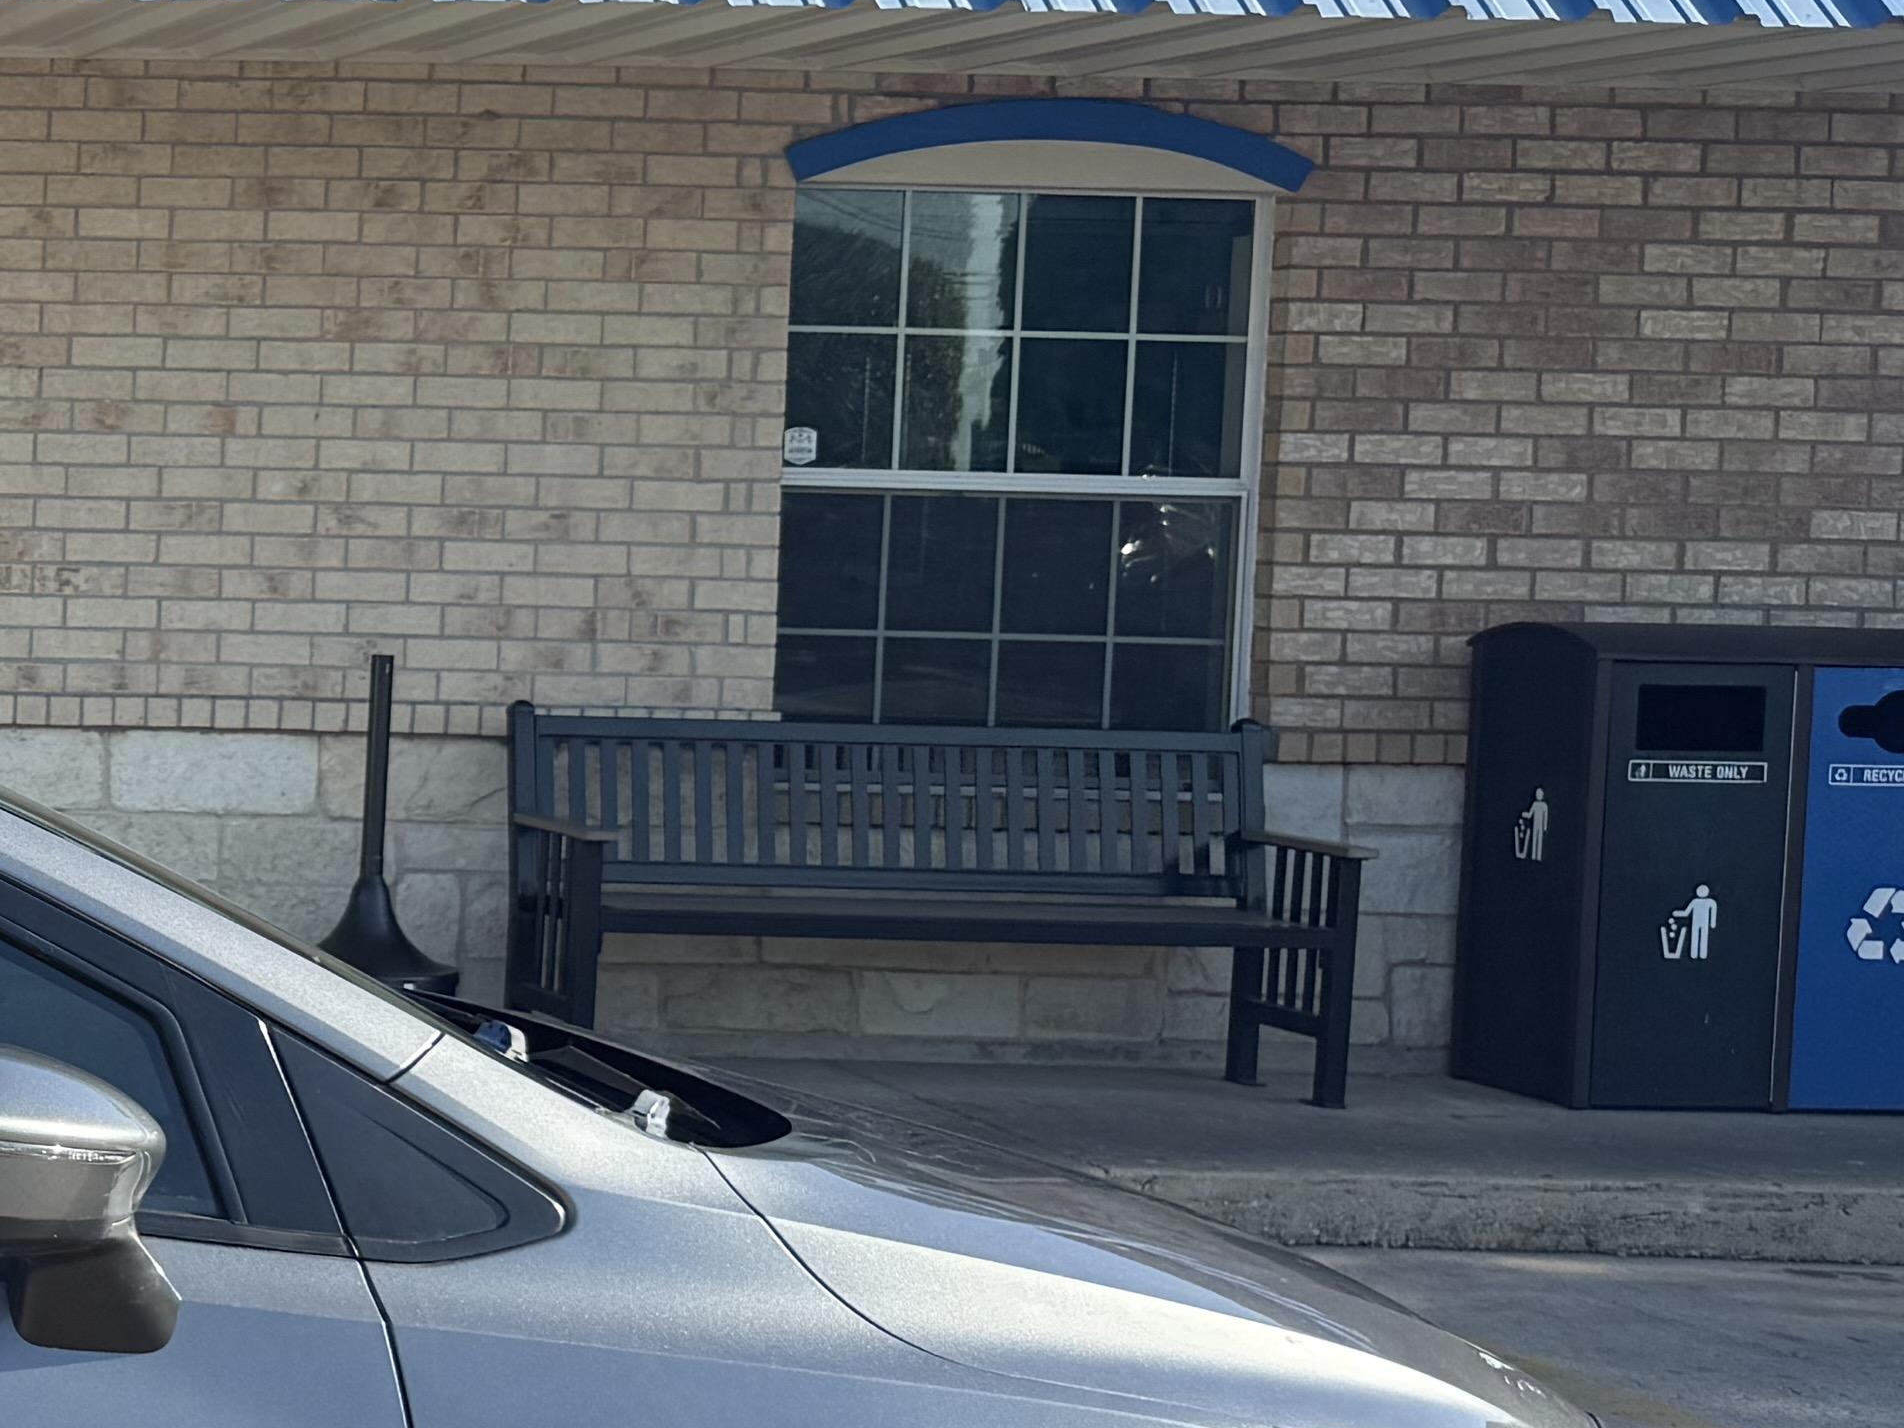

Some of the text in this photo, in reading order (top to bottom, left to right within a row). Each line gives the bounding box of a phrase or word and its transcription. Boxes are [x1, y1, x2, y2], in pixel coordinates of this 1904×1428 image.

[1669, 764, 1749, 780] WASTE ONLY
[1863, 769, 1904, 782] RECYC
